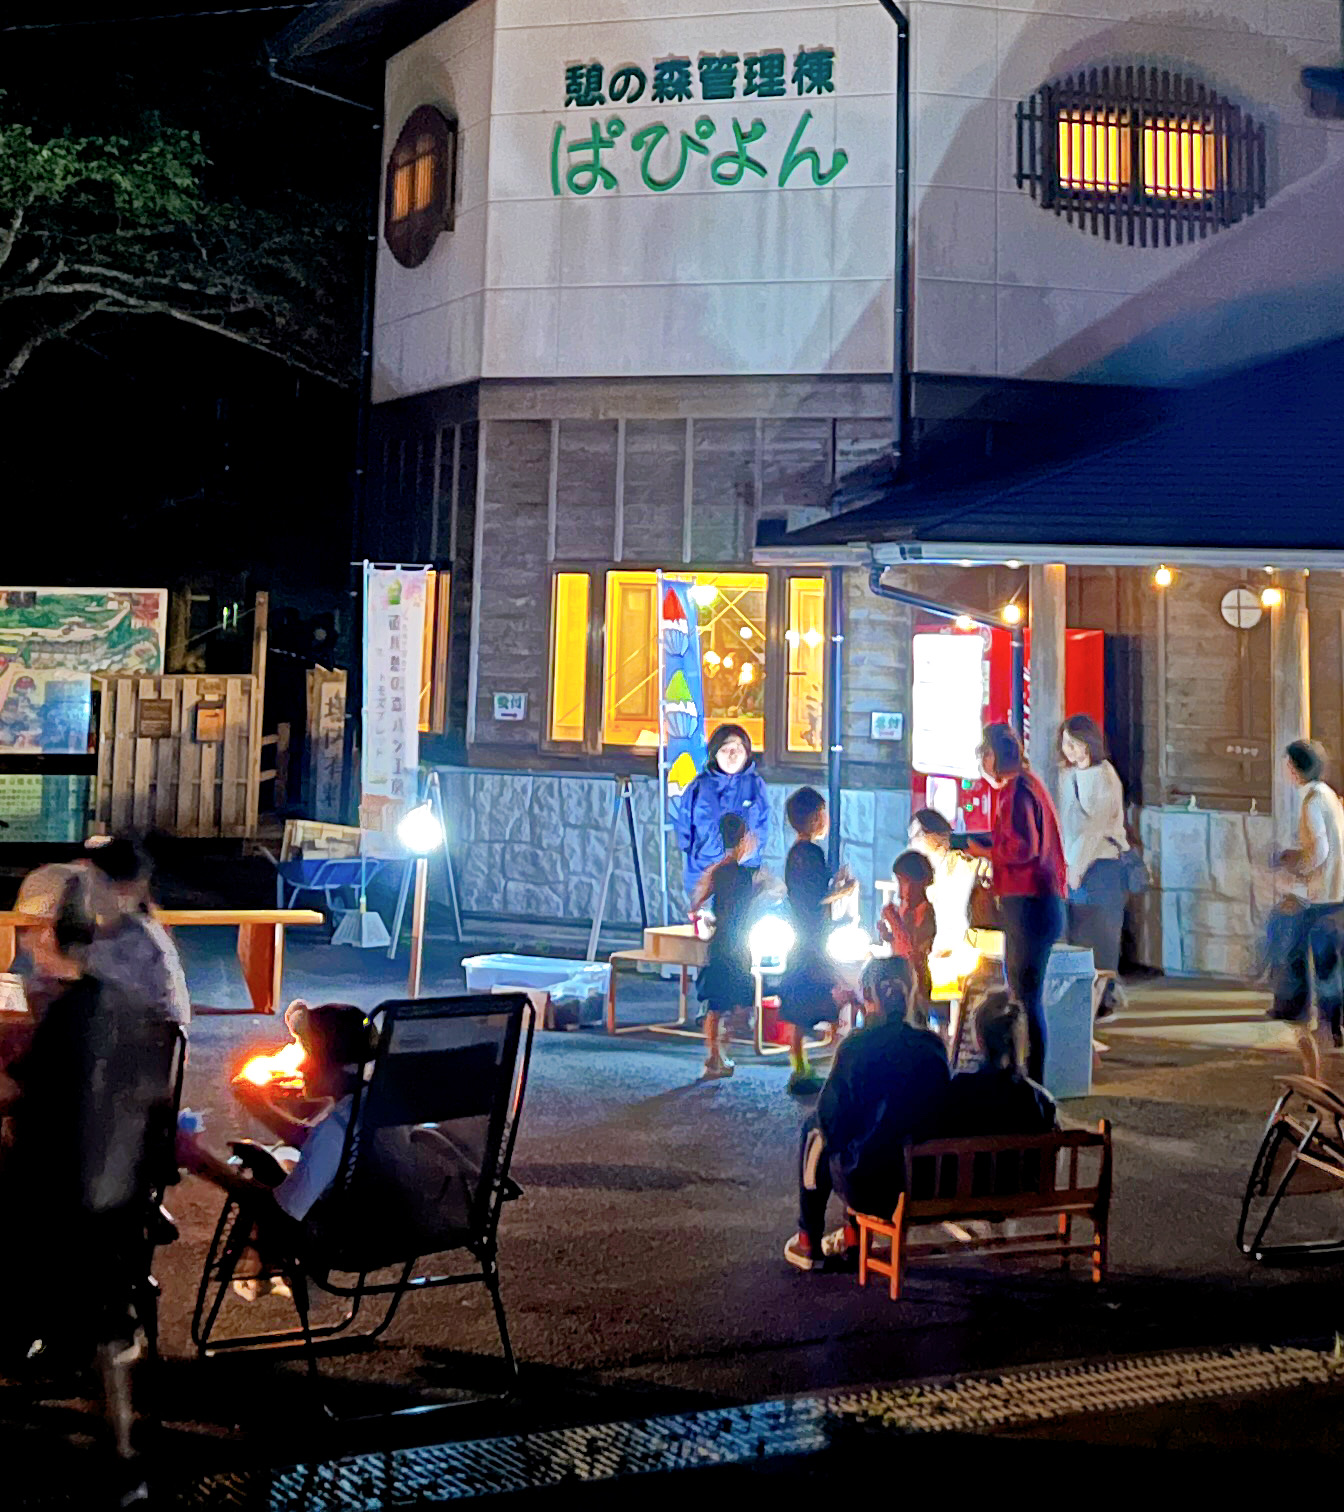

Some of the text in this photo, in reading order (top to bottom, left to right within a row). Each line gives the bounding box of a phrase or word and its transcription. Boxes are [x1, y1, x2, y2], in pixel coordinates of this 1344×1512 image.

[564, 48, 836, 108] 憩の森管理棟
[551, 110, 848, 196] ぱぴよん
